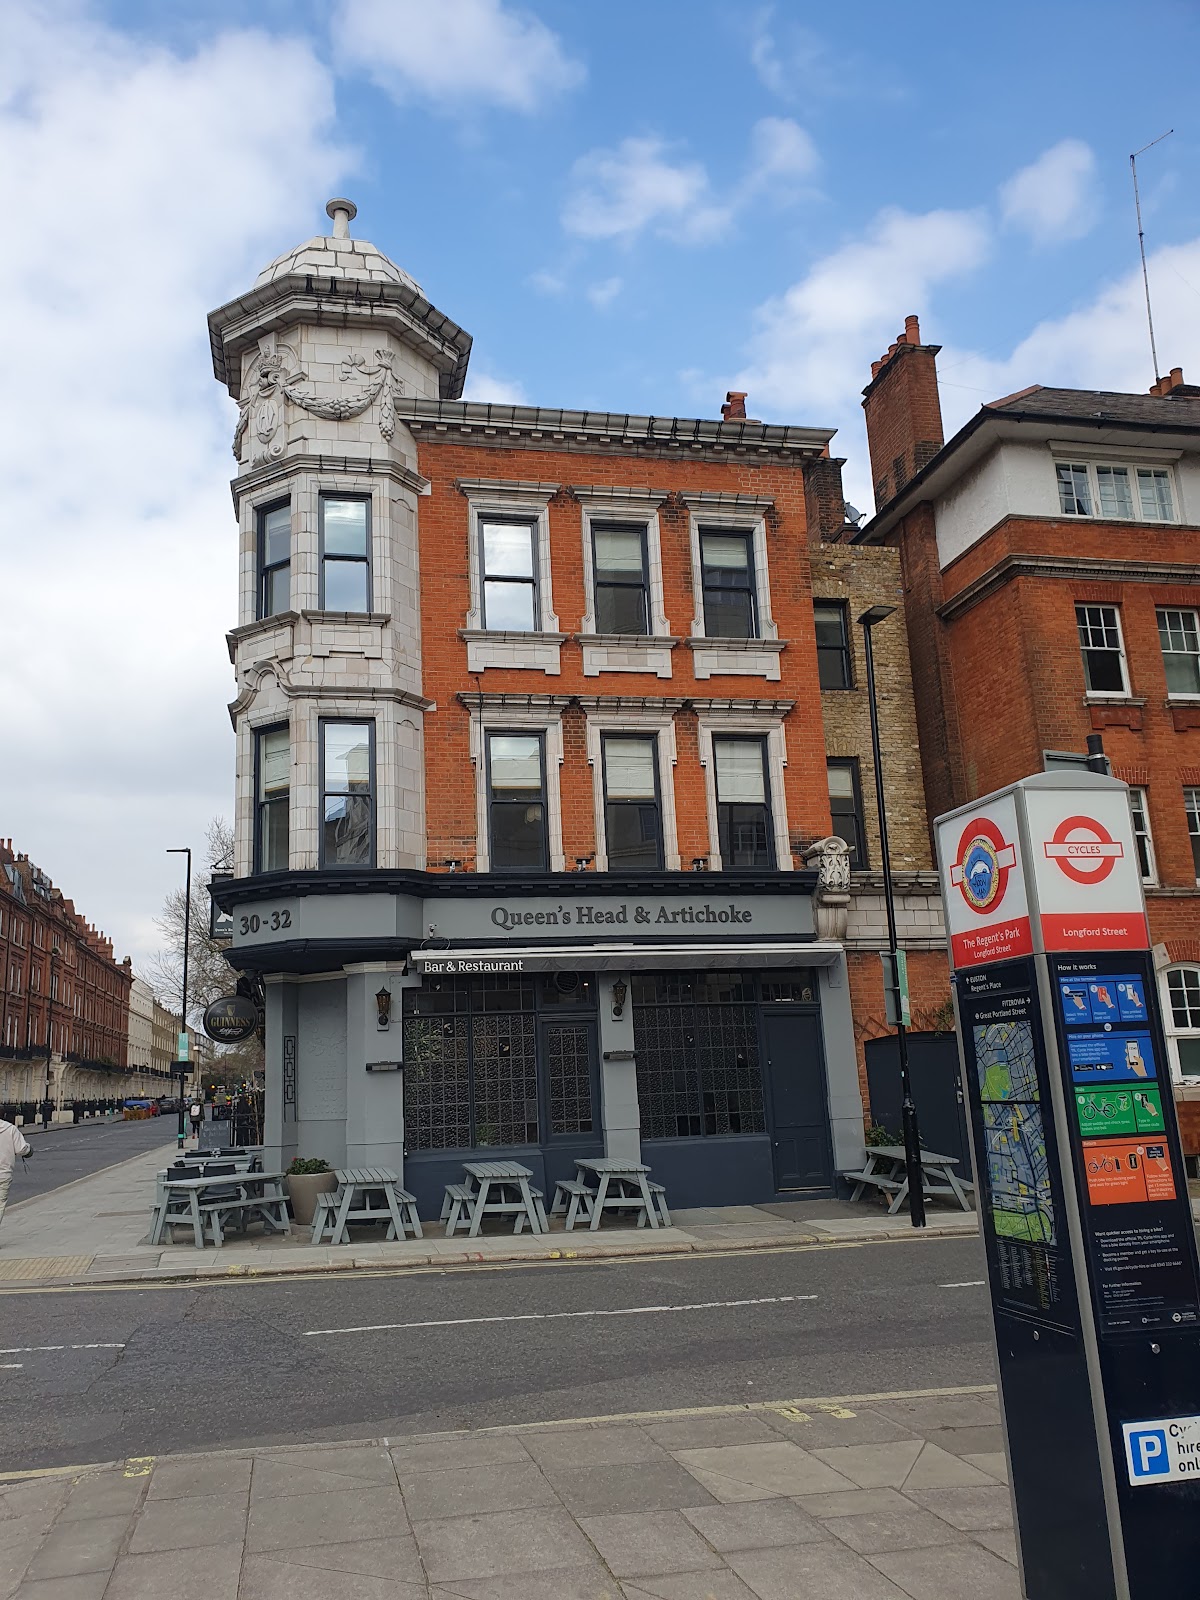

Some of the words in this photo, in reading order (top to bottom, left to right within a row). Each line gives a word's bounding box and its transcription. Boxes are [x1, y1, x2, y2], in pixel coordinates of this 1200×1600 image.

[1068, 846, 1100, 854] CYCLES
[240, 910, 292, 936] 30-32
[490, 905, 571, 930] Queen's
[576, 906, 628, 924] Head
[634, 906, 651, 924] &
[654, 904, 752, 924] Artichoke
[962, 938, 976, 949] The
[976, 931, 1004, 947] Regent's
[1004, 927, 1020, 940] Park
[1062, 928, 1100, 938] Longford
[1102, 928, 1128, 936] Street
[974, 946, 996, 958] Longford
[996, 944, 1012, 954] Street
[424, 962, 444, 972] Bar
[446, 961, 456, 972] &
[458, 960, 523, 972] Restaurant
[971, 984, 989, 992] Regent's
[1002, 998, 1025, 1007] FITZROVIA
[992, 1009, 1011, 1018] Portland
[210, 1016, 250, 1027] GUINNESS
[1139, 1435, 1162, 1472] P
[1179, 1457, 1200, 1472] onl
